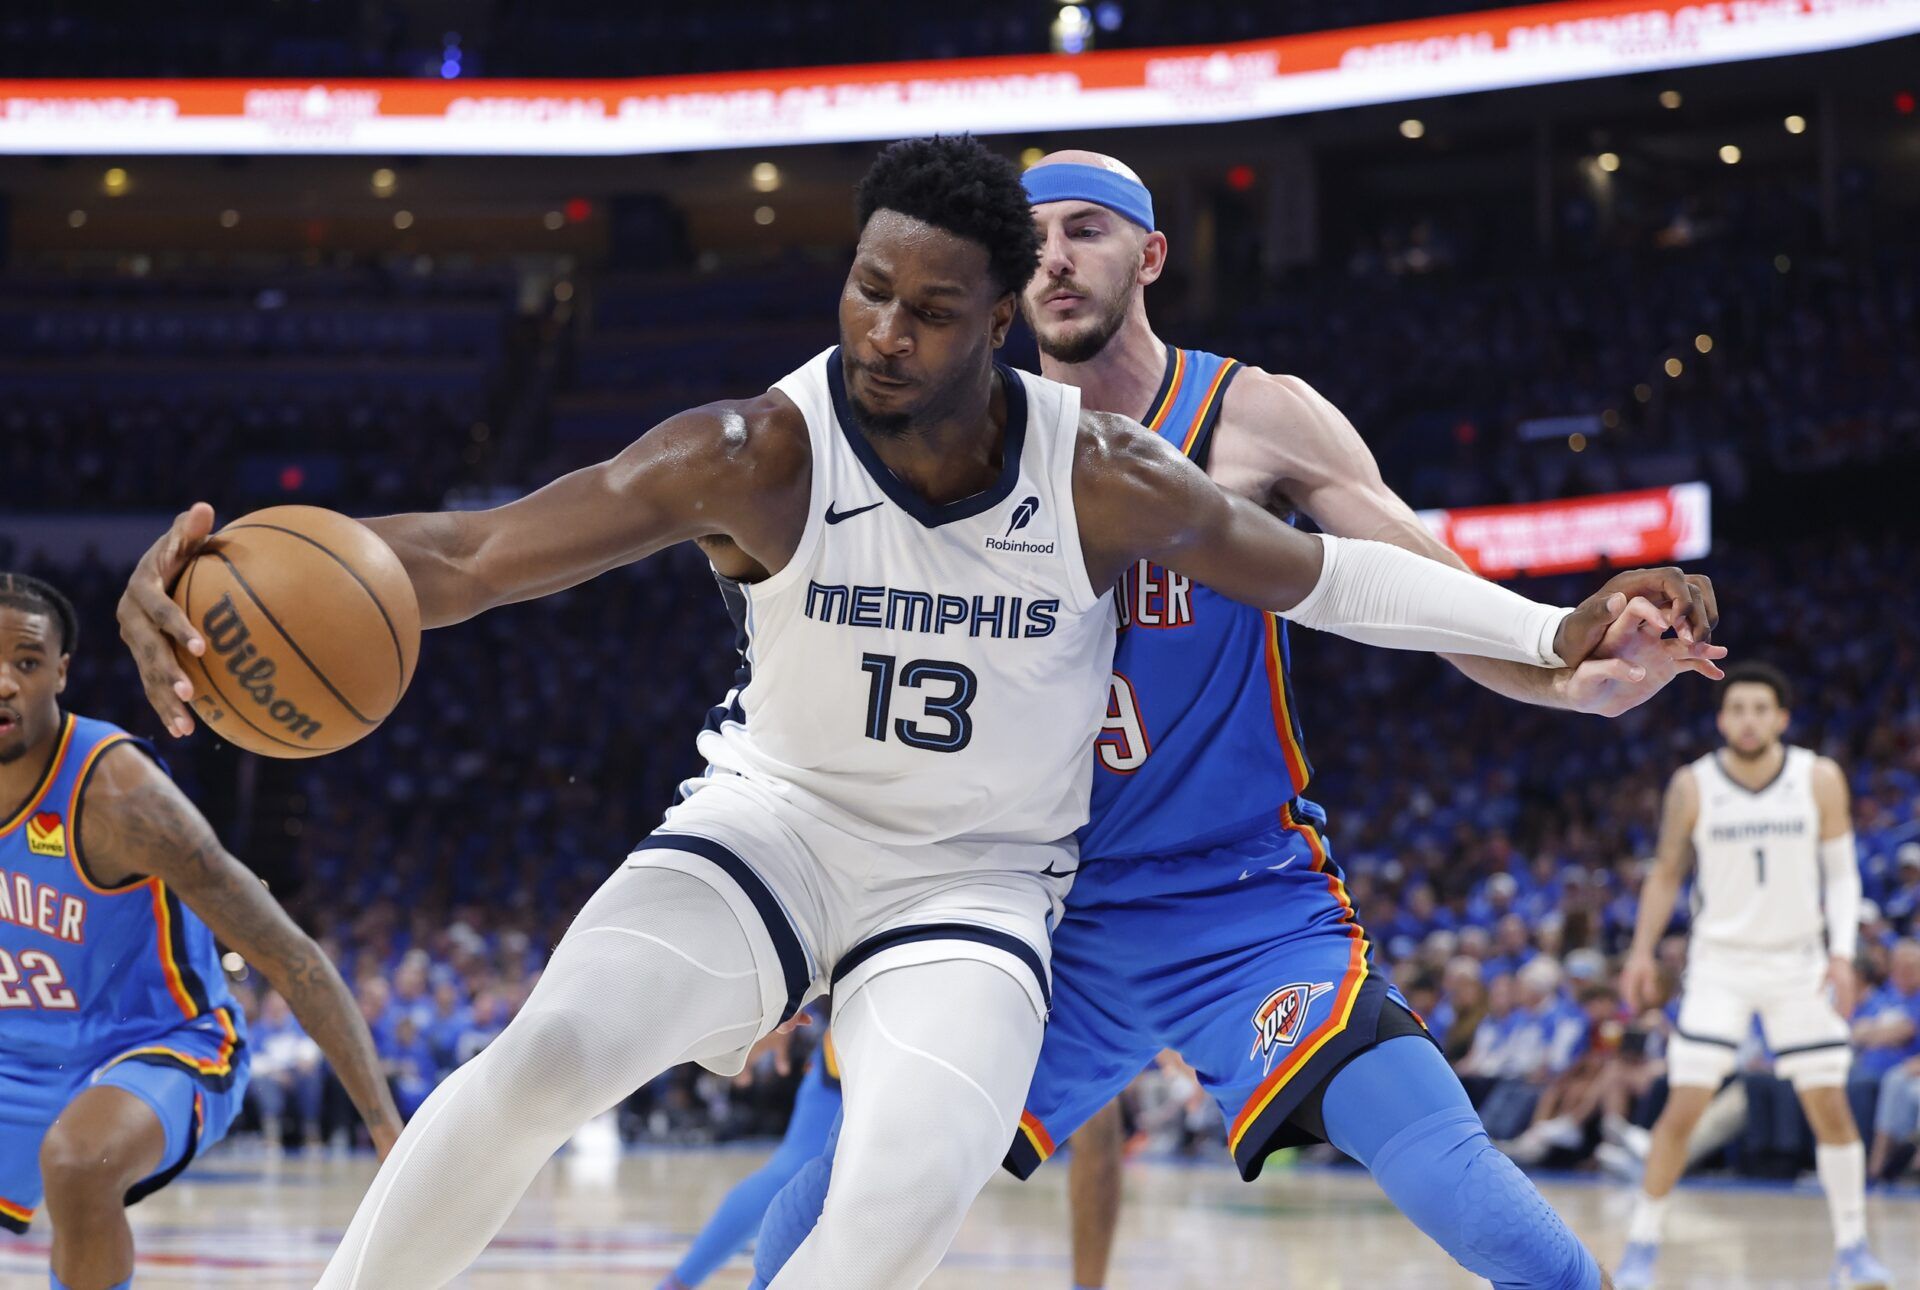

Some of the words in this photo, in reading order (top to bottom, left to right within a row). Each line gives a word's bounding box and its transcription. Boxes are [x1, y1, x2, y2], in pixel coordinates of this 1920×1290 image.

[985, 537, 1055, 554] Robinhood
[805, 580, 1060, 639] MEMPHIS
[203, 591, 323, 741] Wilson
[862, 652, 978, 754] 13
[1755, 847, 1767, 885] 1
[0, 947, 80, 1010] 22
[1262, 992, 1297, 1054] OKC
